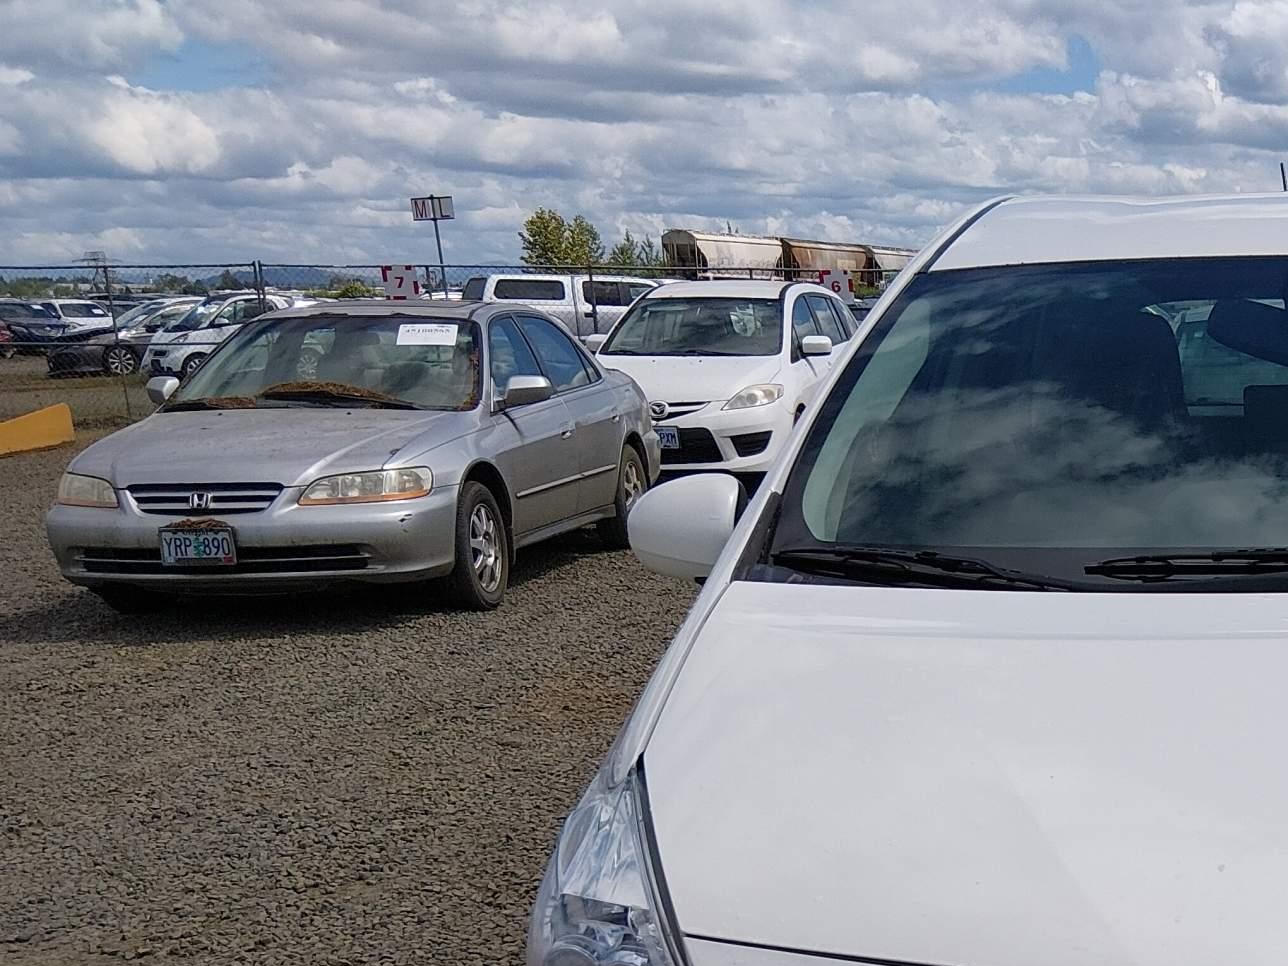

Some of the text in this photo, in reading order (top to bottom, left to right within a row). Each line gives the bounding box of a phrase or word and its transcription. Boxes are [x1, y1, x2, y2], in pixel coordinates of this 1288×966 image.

[414, 198, 451, 218] M L
[394, 276, 404, 289] 7
[831, 281, 842, 293] 6
[164, 537, 231, 557] YRP 890
